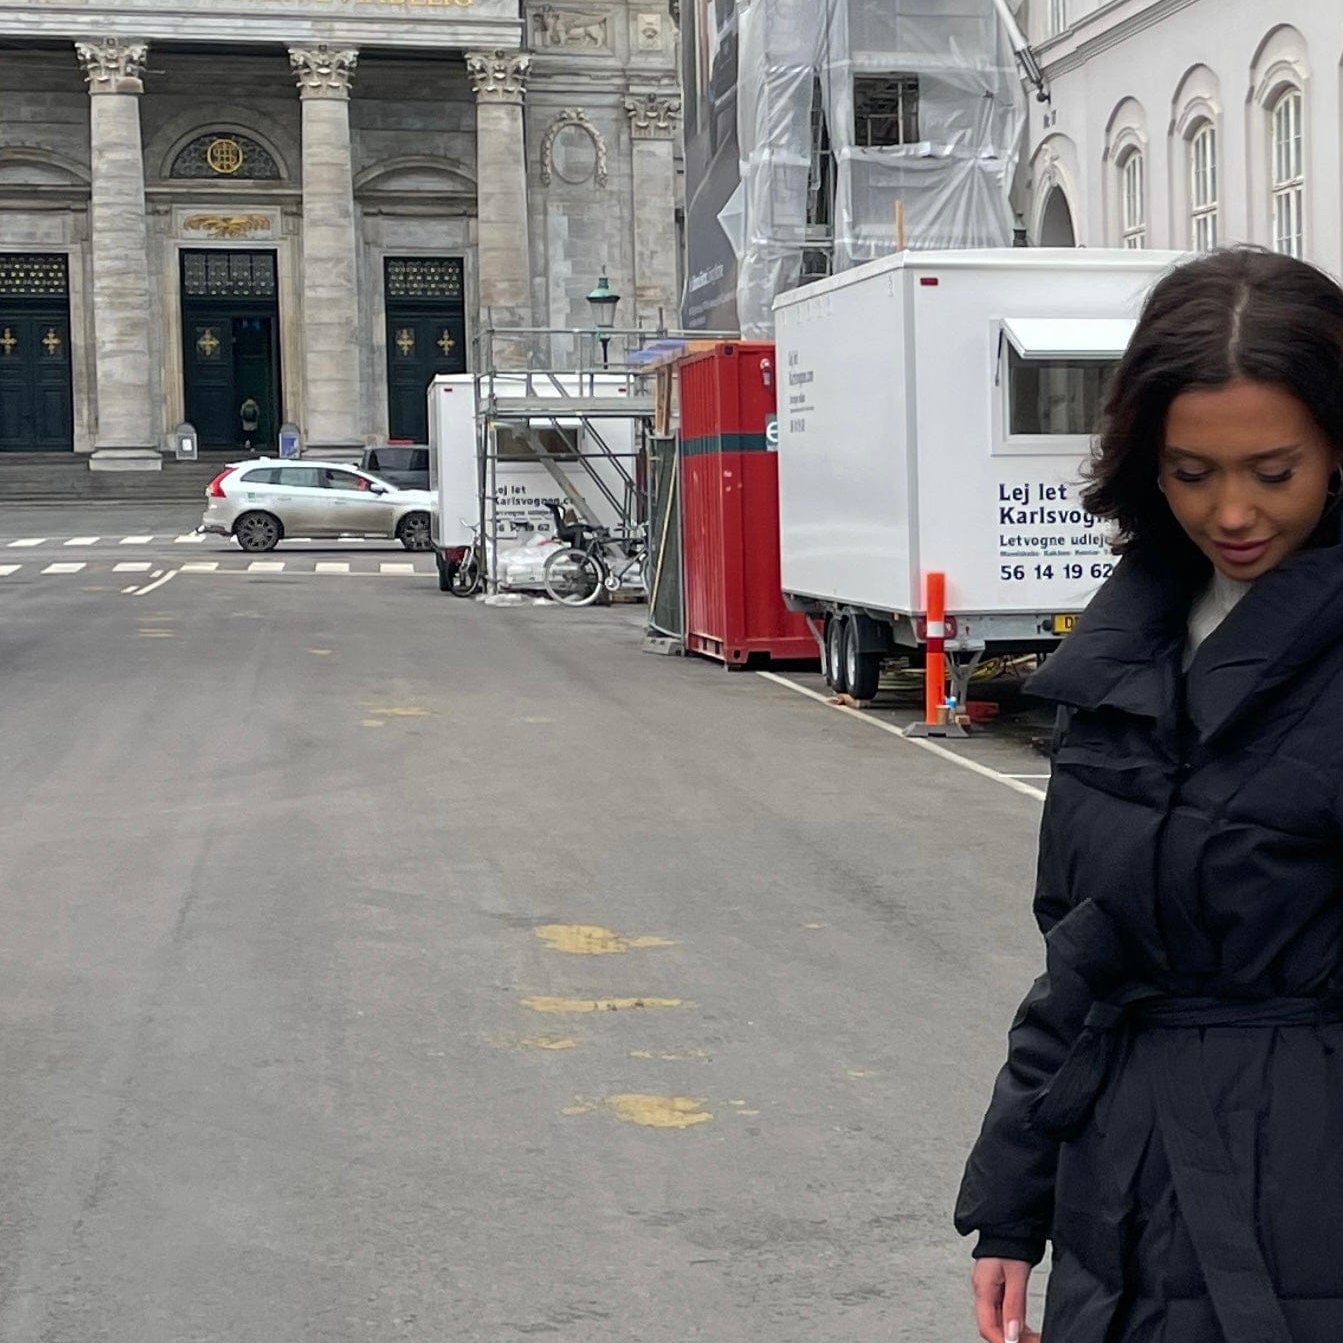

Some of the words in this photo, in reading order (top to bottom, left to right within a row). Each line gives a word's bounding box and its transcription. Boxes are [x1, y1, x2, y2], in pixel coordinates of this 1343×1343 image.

[511, 485, 526, 494] let
[999, 483, 1030, 505] Lej
[1039, 483, 1067, 500] let
[999, 534, 1065, 549] Letvogne
[1000, 565, 1025, 580] 56
[1034, 564, 1053, 579] 14
[1063, 563, 1082, 579] 19
[1090, 563, 1113, 579] 62
